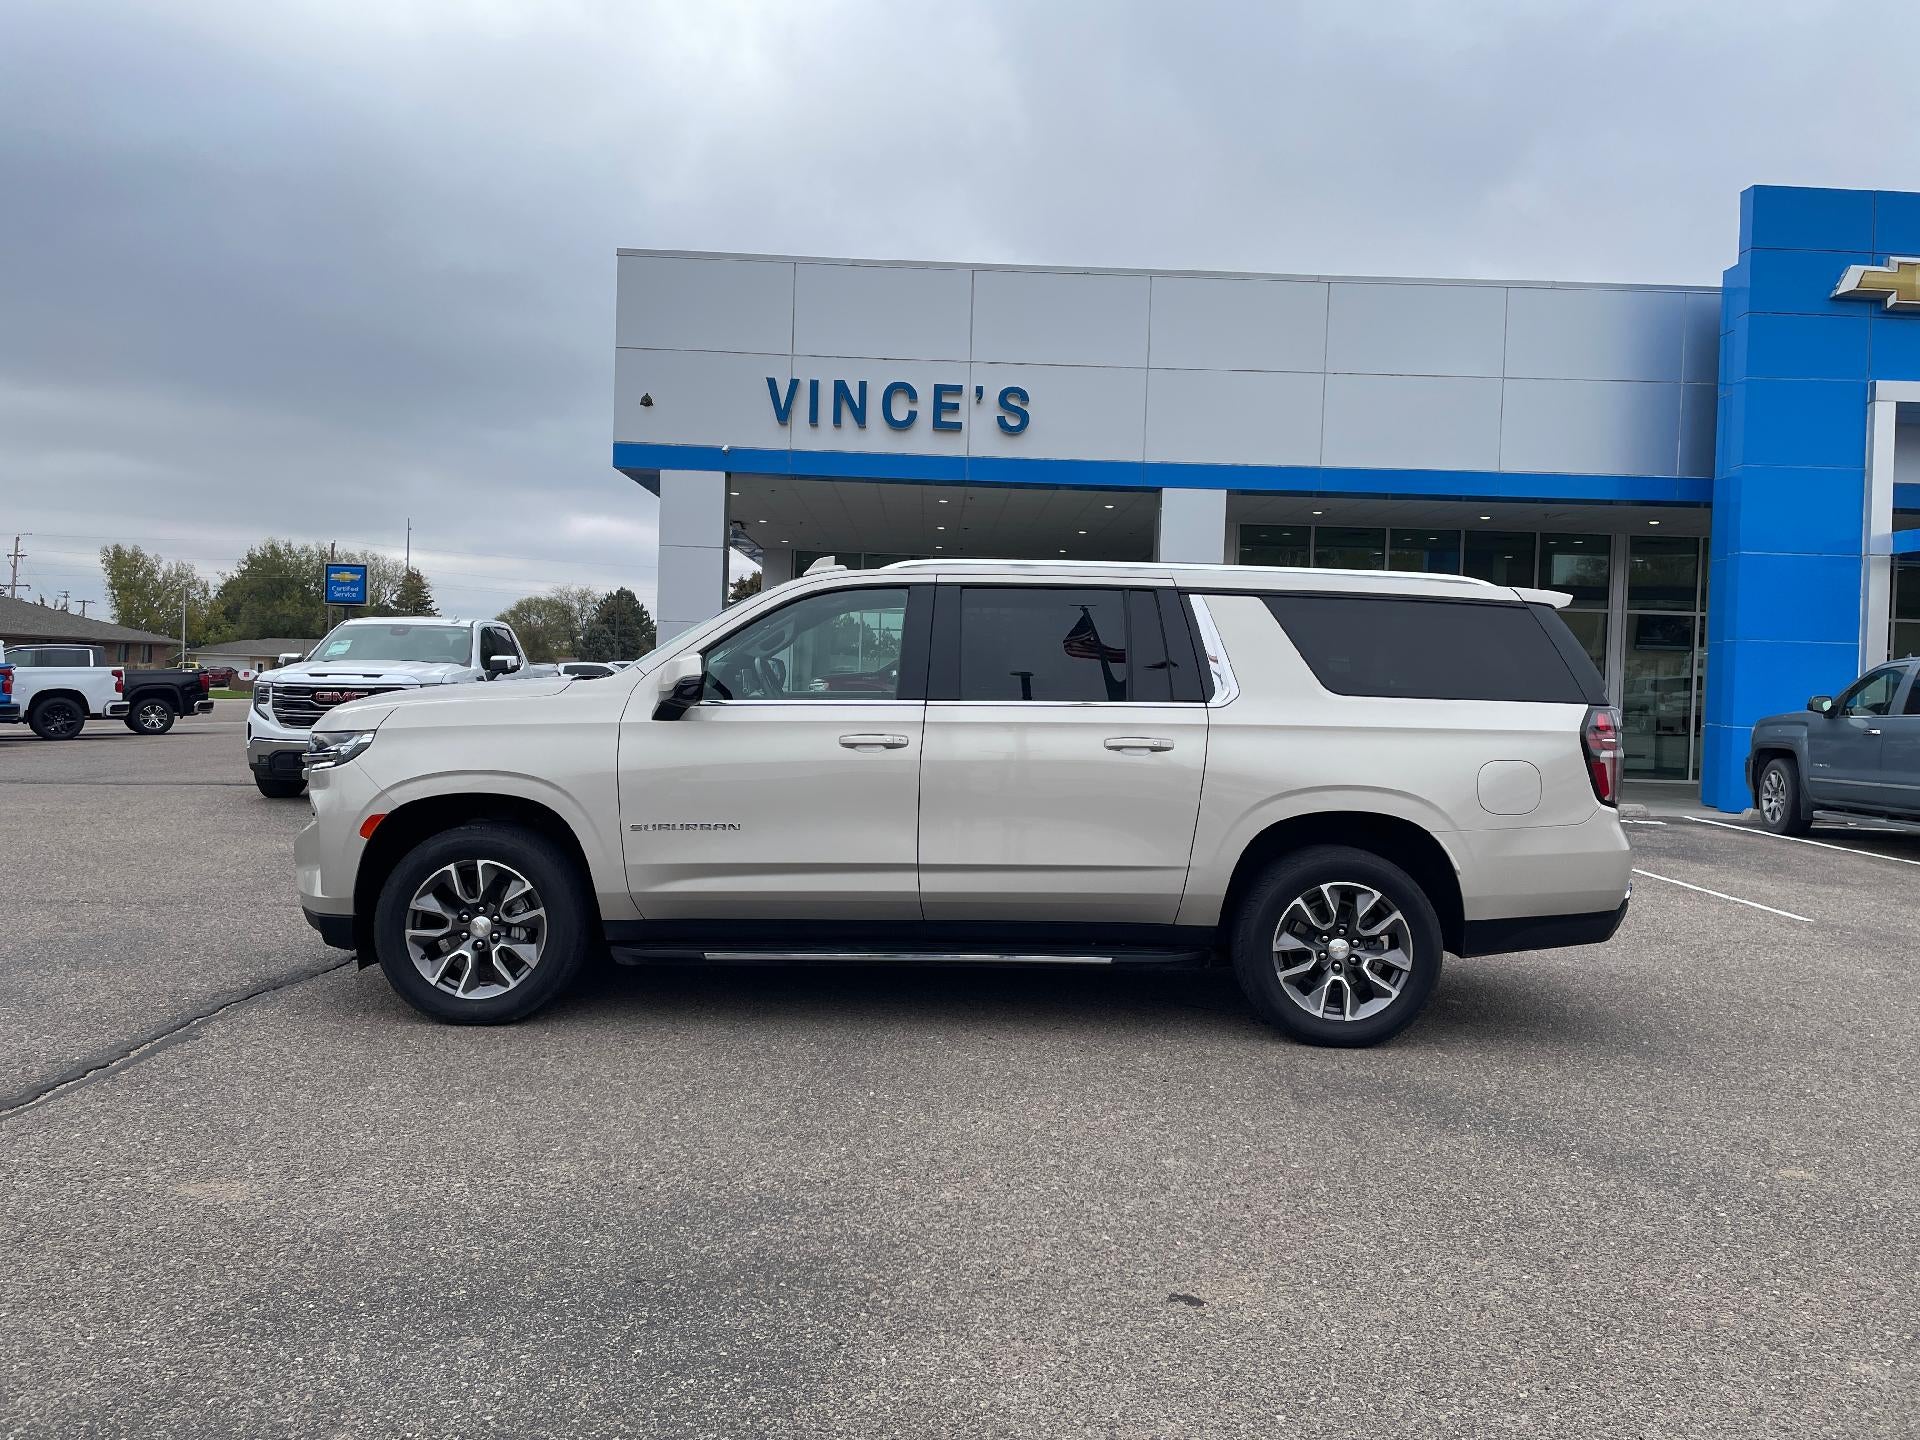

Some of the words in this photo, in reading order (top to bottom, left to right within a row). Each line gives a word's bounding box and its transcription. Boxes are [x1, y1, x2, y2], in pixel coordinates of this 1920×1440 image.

[766, 376, 1030, 435] VINCE'S
[315, 691, 369, 702] GMC
[629, 823, 742, 832] SUBURBAN
